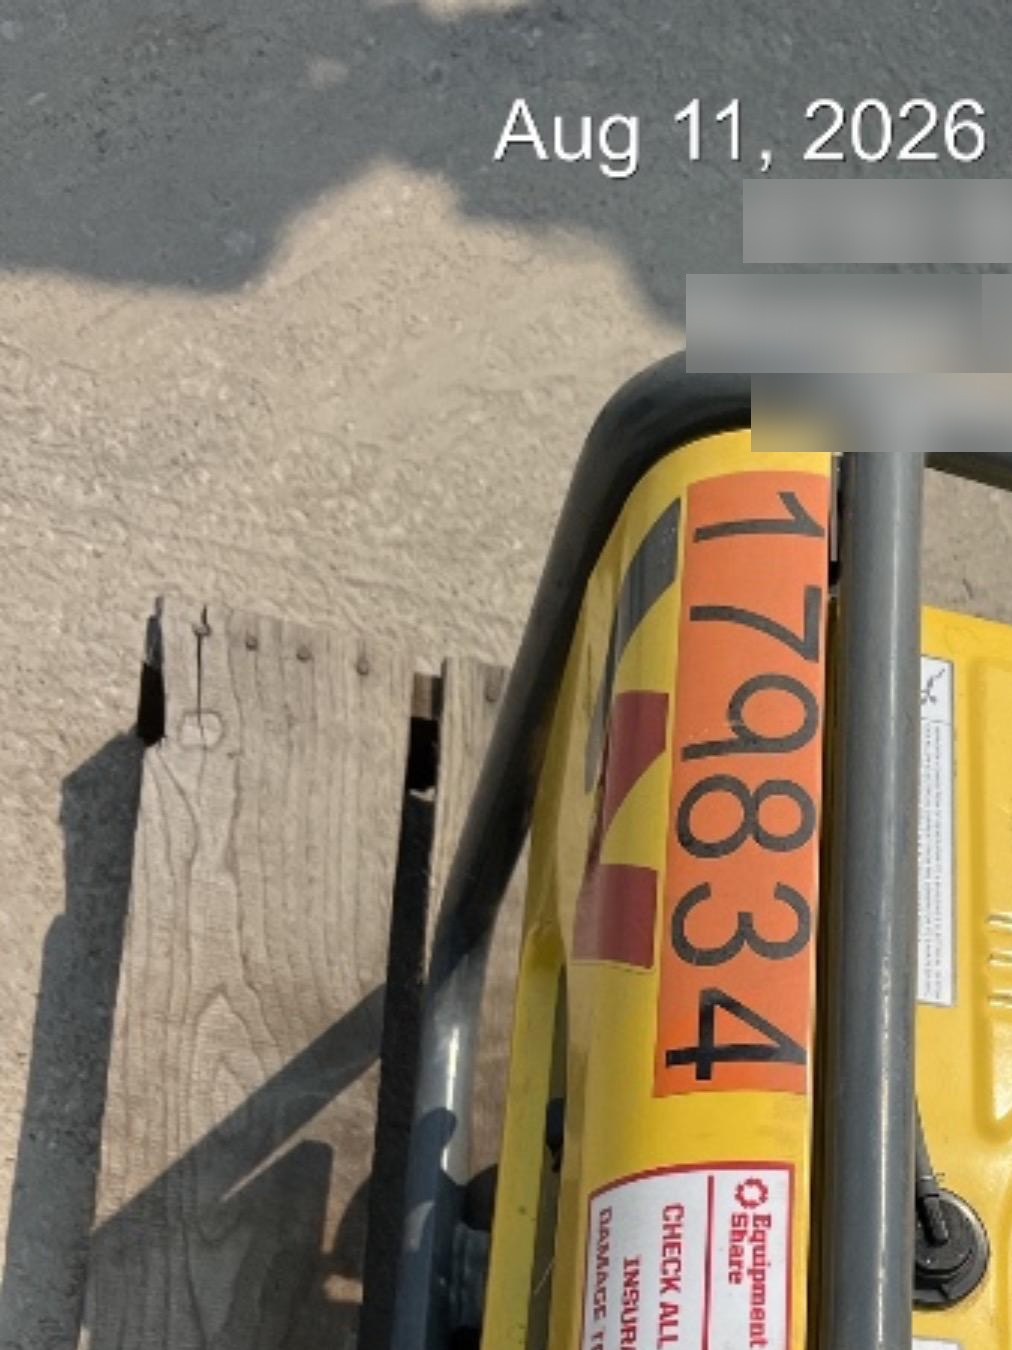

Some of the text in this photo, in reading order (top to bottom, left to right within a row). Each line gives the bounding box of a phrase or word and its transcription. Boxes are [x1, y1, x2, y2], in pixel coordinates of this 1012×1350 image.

[665, 491, 825, 1082] 179834
[593, 1205, 614, 1322] DAMAGE
[658, 1204, 685, 1294] CHECK
[727, 1211, 749, 1286] Share
[747, 1213, 773, 1349] Equipment
[656, 1302, 681, 1350] ALL
